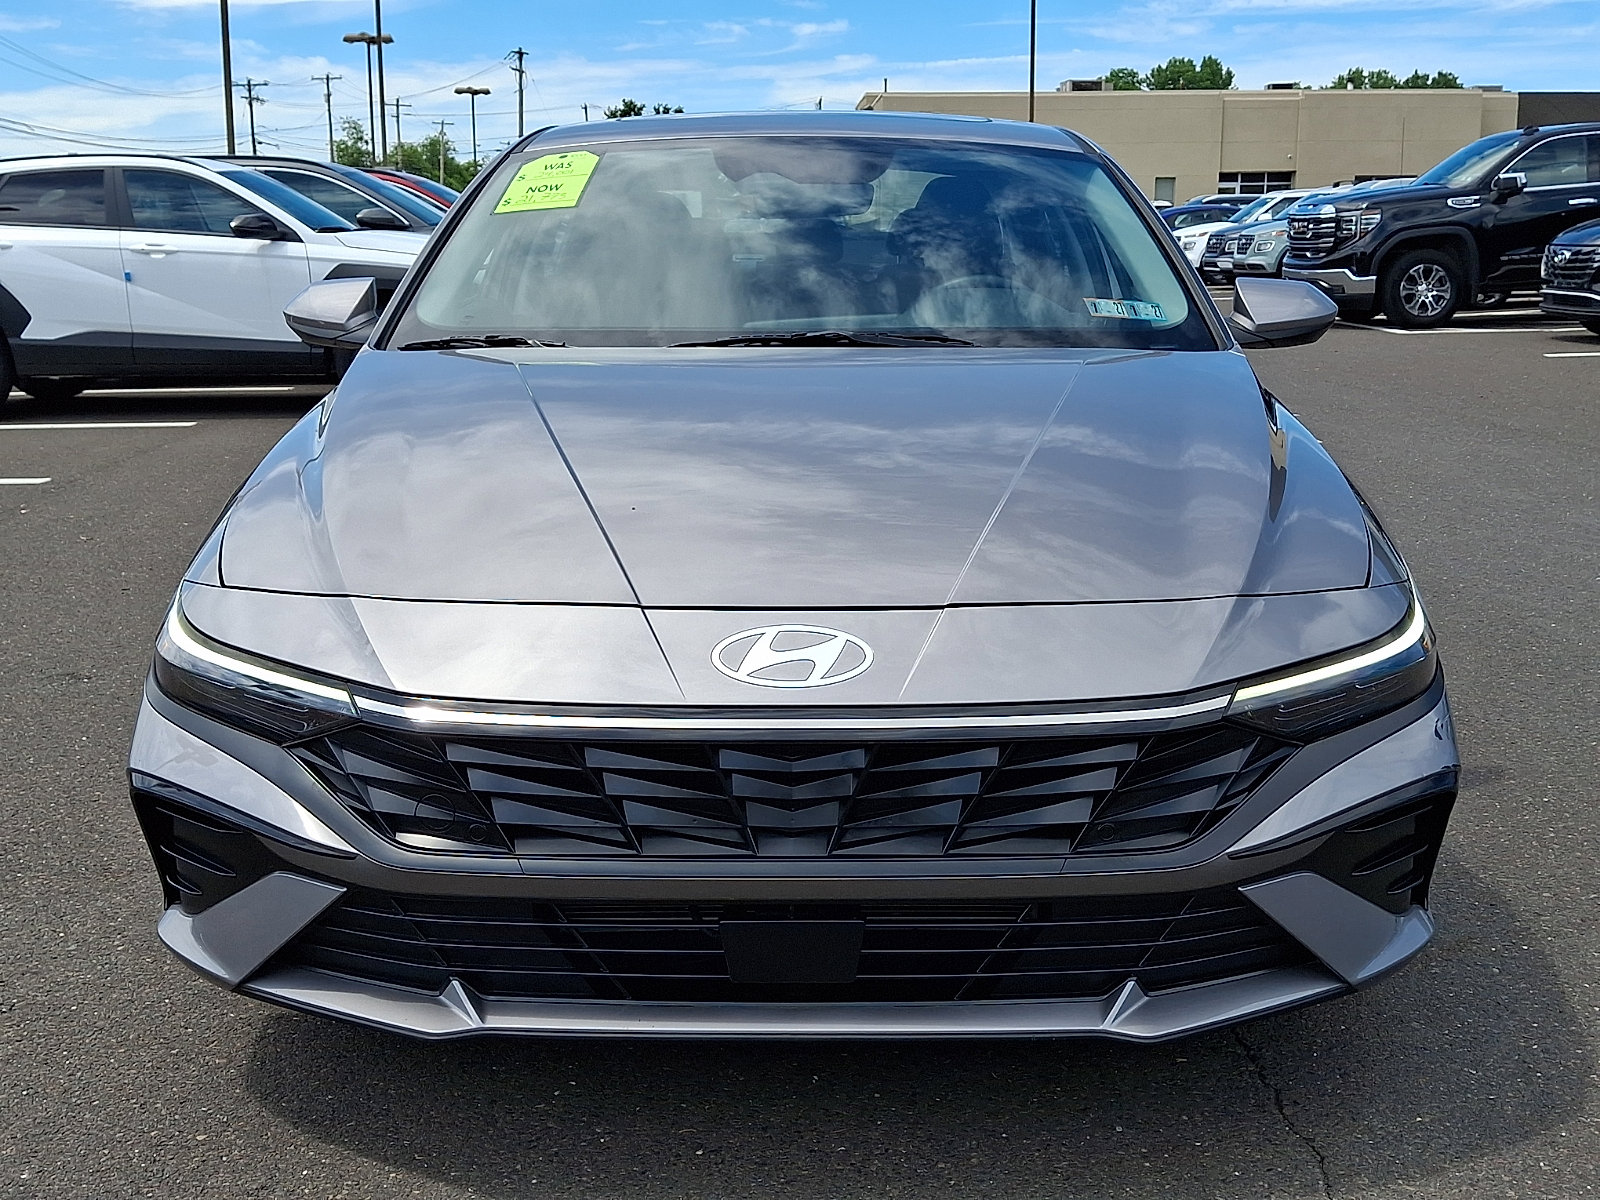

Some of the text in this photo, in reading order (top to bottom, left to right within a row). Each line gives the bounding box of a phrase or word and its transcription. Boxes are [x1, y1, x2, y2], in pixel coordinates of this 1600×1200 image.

[544, 160, 574, 171] WAS
[526, 183, 564, 194] NOW
[501, 197, 512, 207] $
